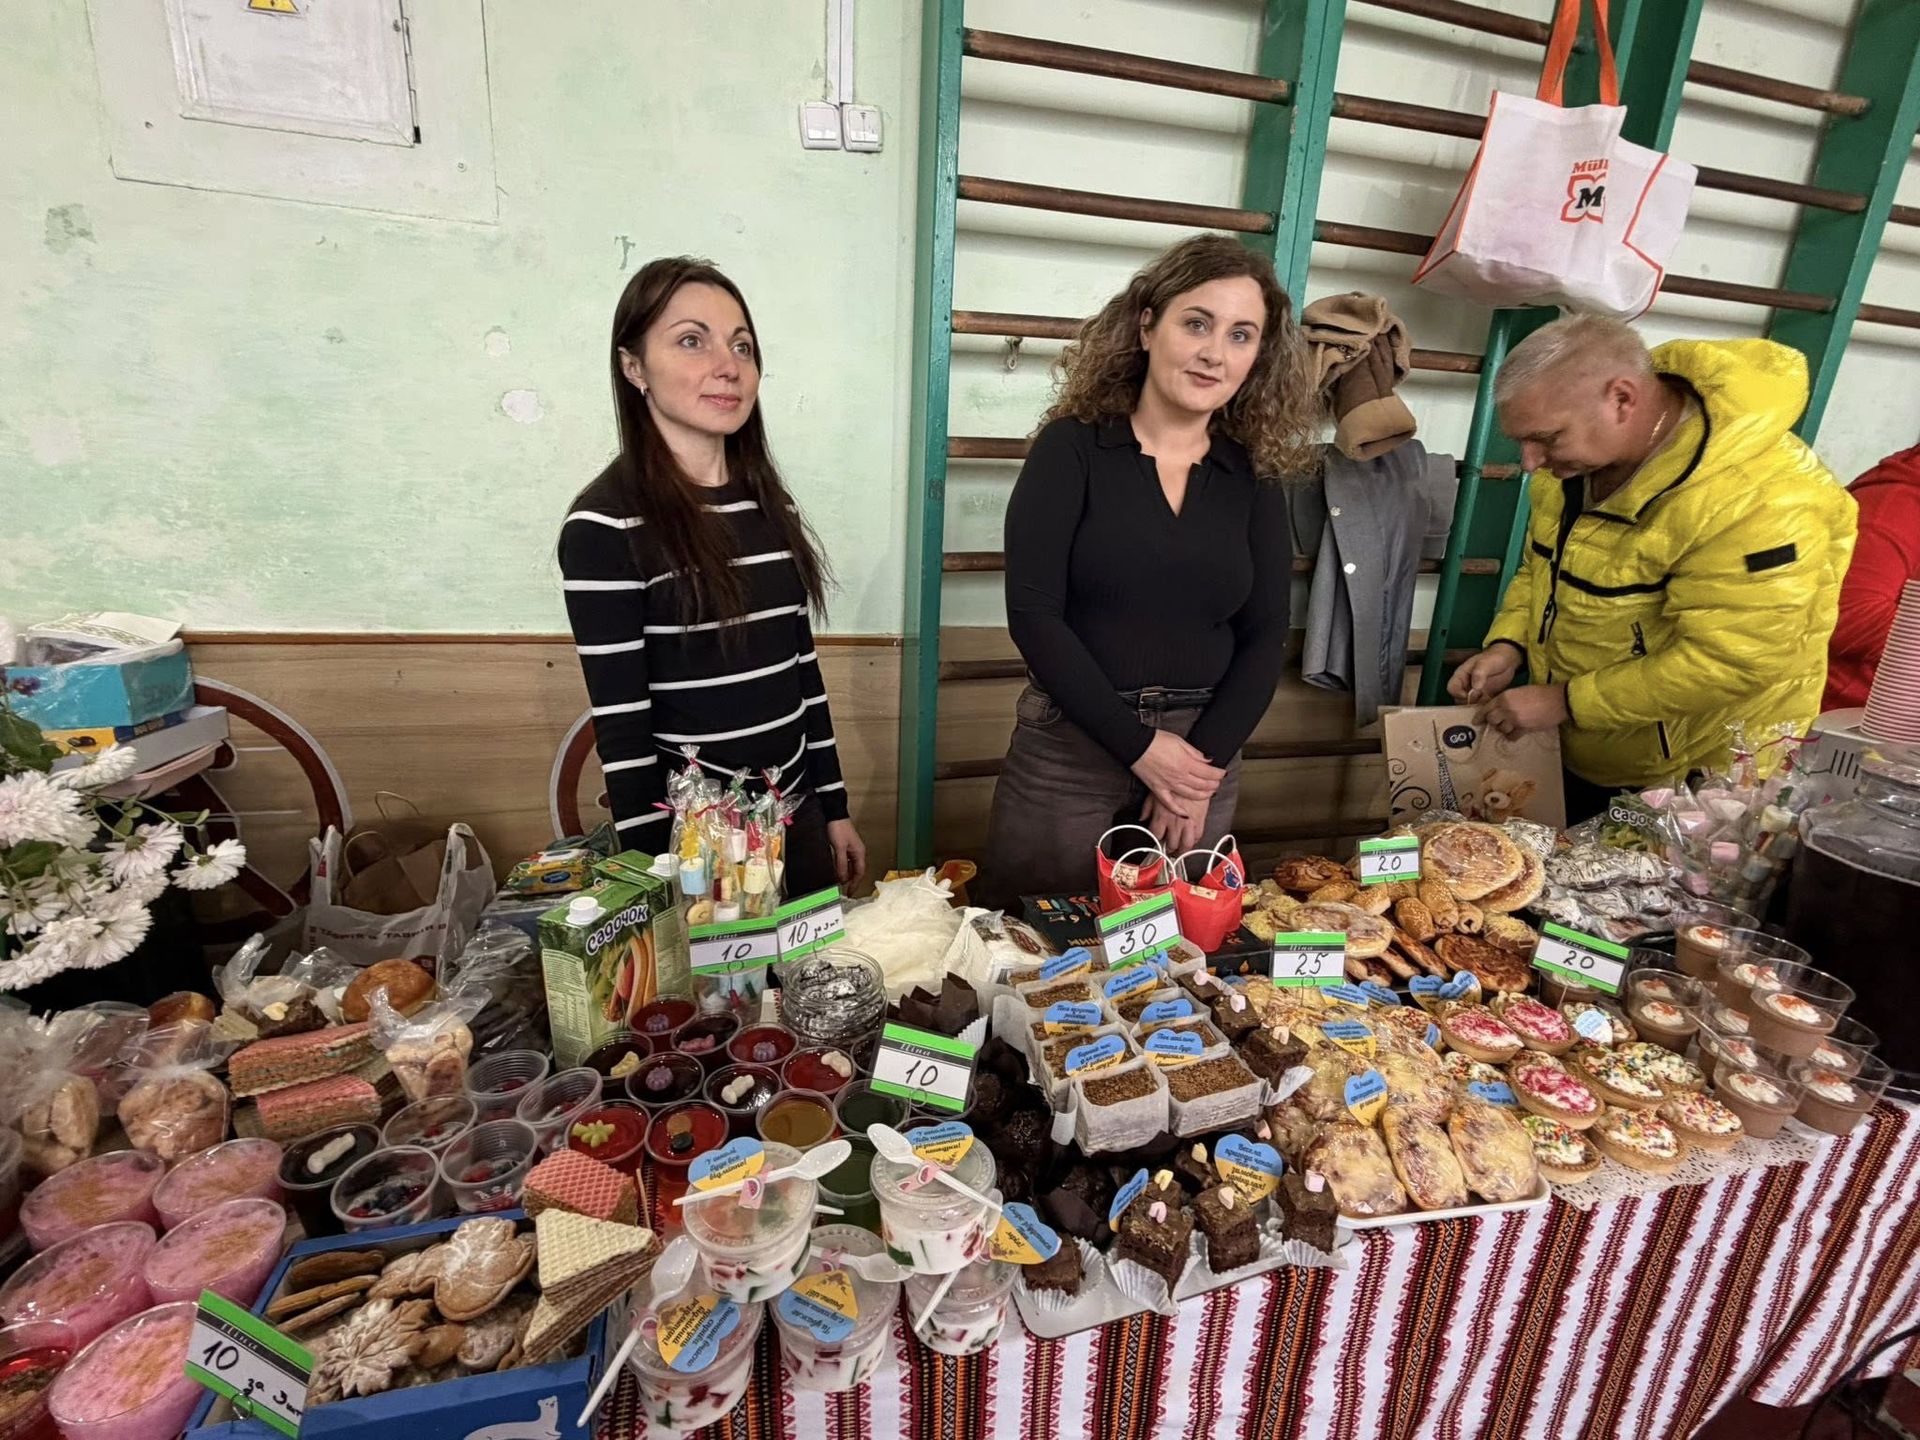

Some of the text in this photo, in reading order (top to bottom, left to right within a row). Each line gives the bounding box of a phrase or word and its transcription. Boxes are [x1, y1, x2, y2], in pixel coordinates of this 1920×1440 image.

[1450, 731, 1473, 744] GO!
[1609, 806, 1655, 829] Садоч
[1378, 855, 1401, 872] 20
[586, 904, 648, 955] Садочок
[788, 921, 808, 947] 10
[1120, 923, 1157, 954] 30
[721, 943, 752, 961] 10
[1295, 952, 1329, 975] 25
[1563, 950, 1595, 969] 20
[900, 1043, 931, 1057] Ціна
[905, 1060, 938, 1086] 10
[709, 1160, 727, 1171] буде
[709, 1158, 747, 1180] відмінно!
[1005, 1231, 1025, 1248] мрія!
[662, 1297, 700, 1346] результат!
[672, 1306, 706, 1345] відмінний
[707, 1306, 735, 1342] Виконані
[220, 1323, 258, 1351] Ціна
[203, 1340, 239, 1371] 10
[272, 1389, 288, 1406] 3
